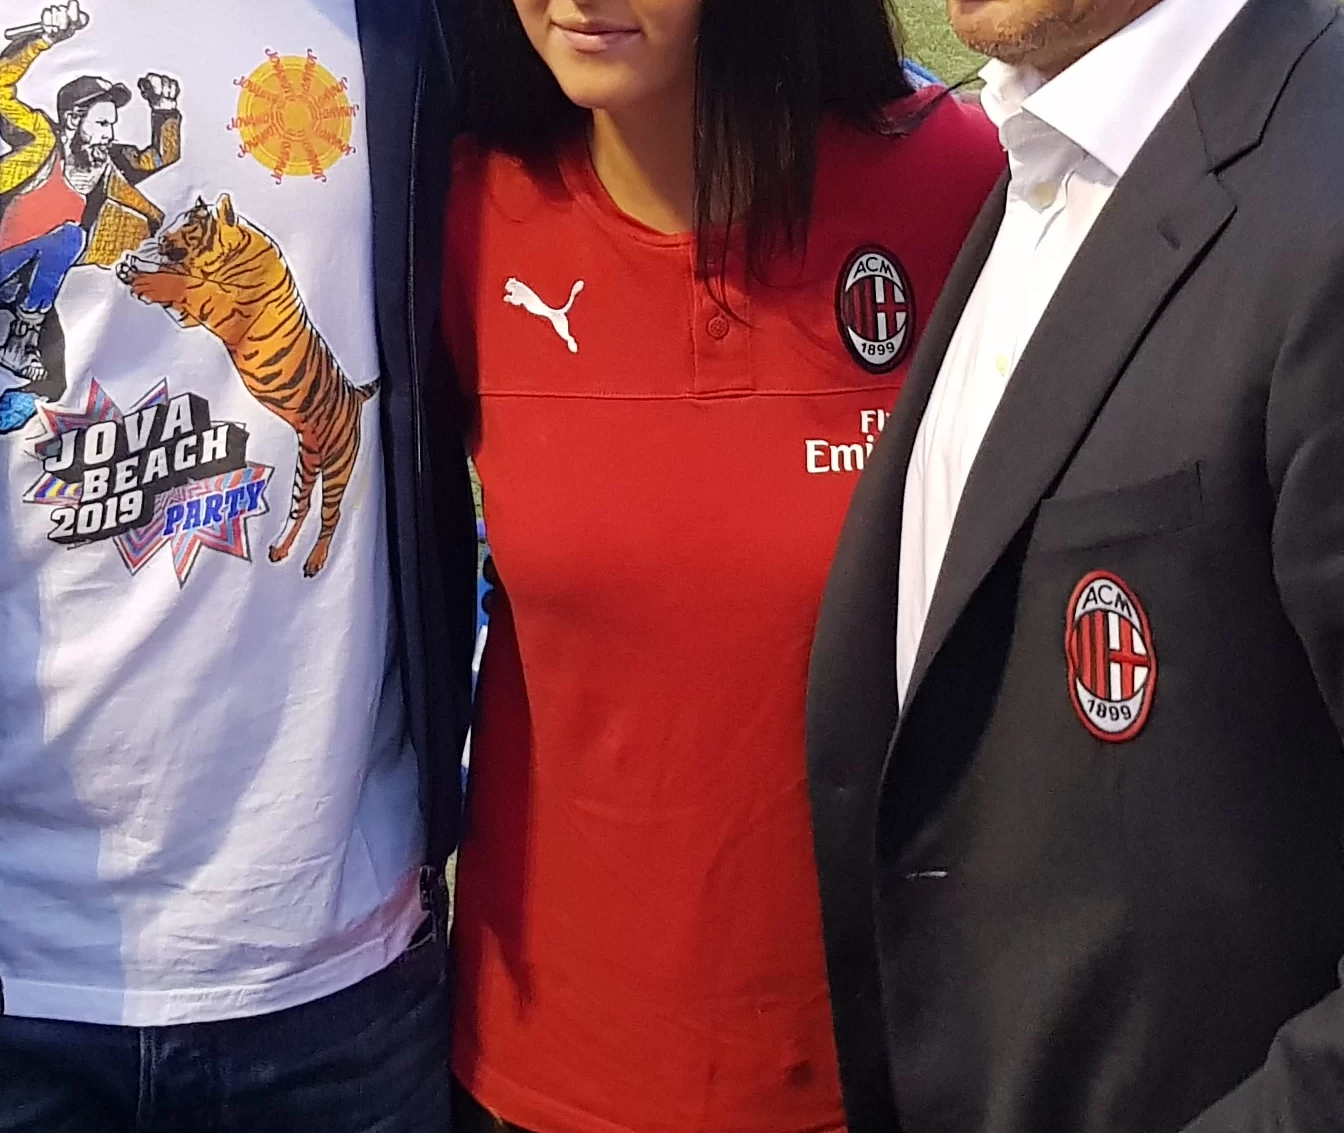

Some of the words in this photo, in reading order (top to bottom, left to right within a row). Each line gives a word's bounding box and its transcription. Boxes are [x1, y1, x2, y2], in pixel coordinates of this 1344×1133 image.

[853, 256, 894, 279] ACM
[861, 342, 895, 356] 1899
[45, 394, 193, 472] JOVA
[860, 410, 892, 434] Fl
[81, 425, 230, 503] BEACH
[805, 434, 874, 474] Emi
[48, 490, 144, 539] 2019
[162, 479, 266, 537] PARTY
[1082, 585, 1132, 618] ACM
[1087, 700, 1132, 721] 1899
